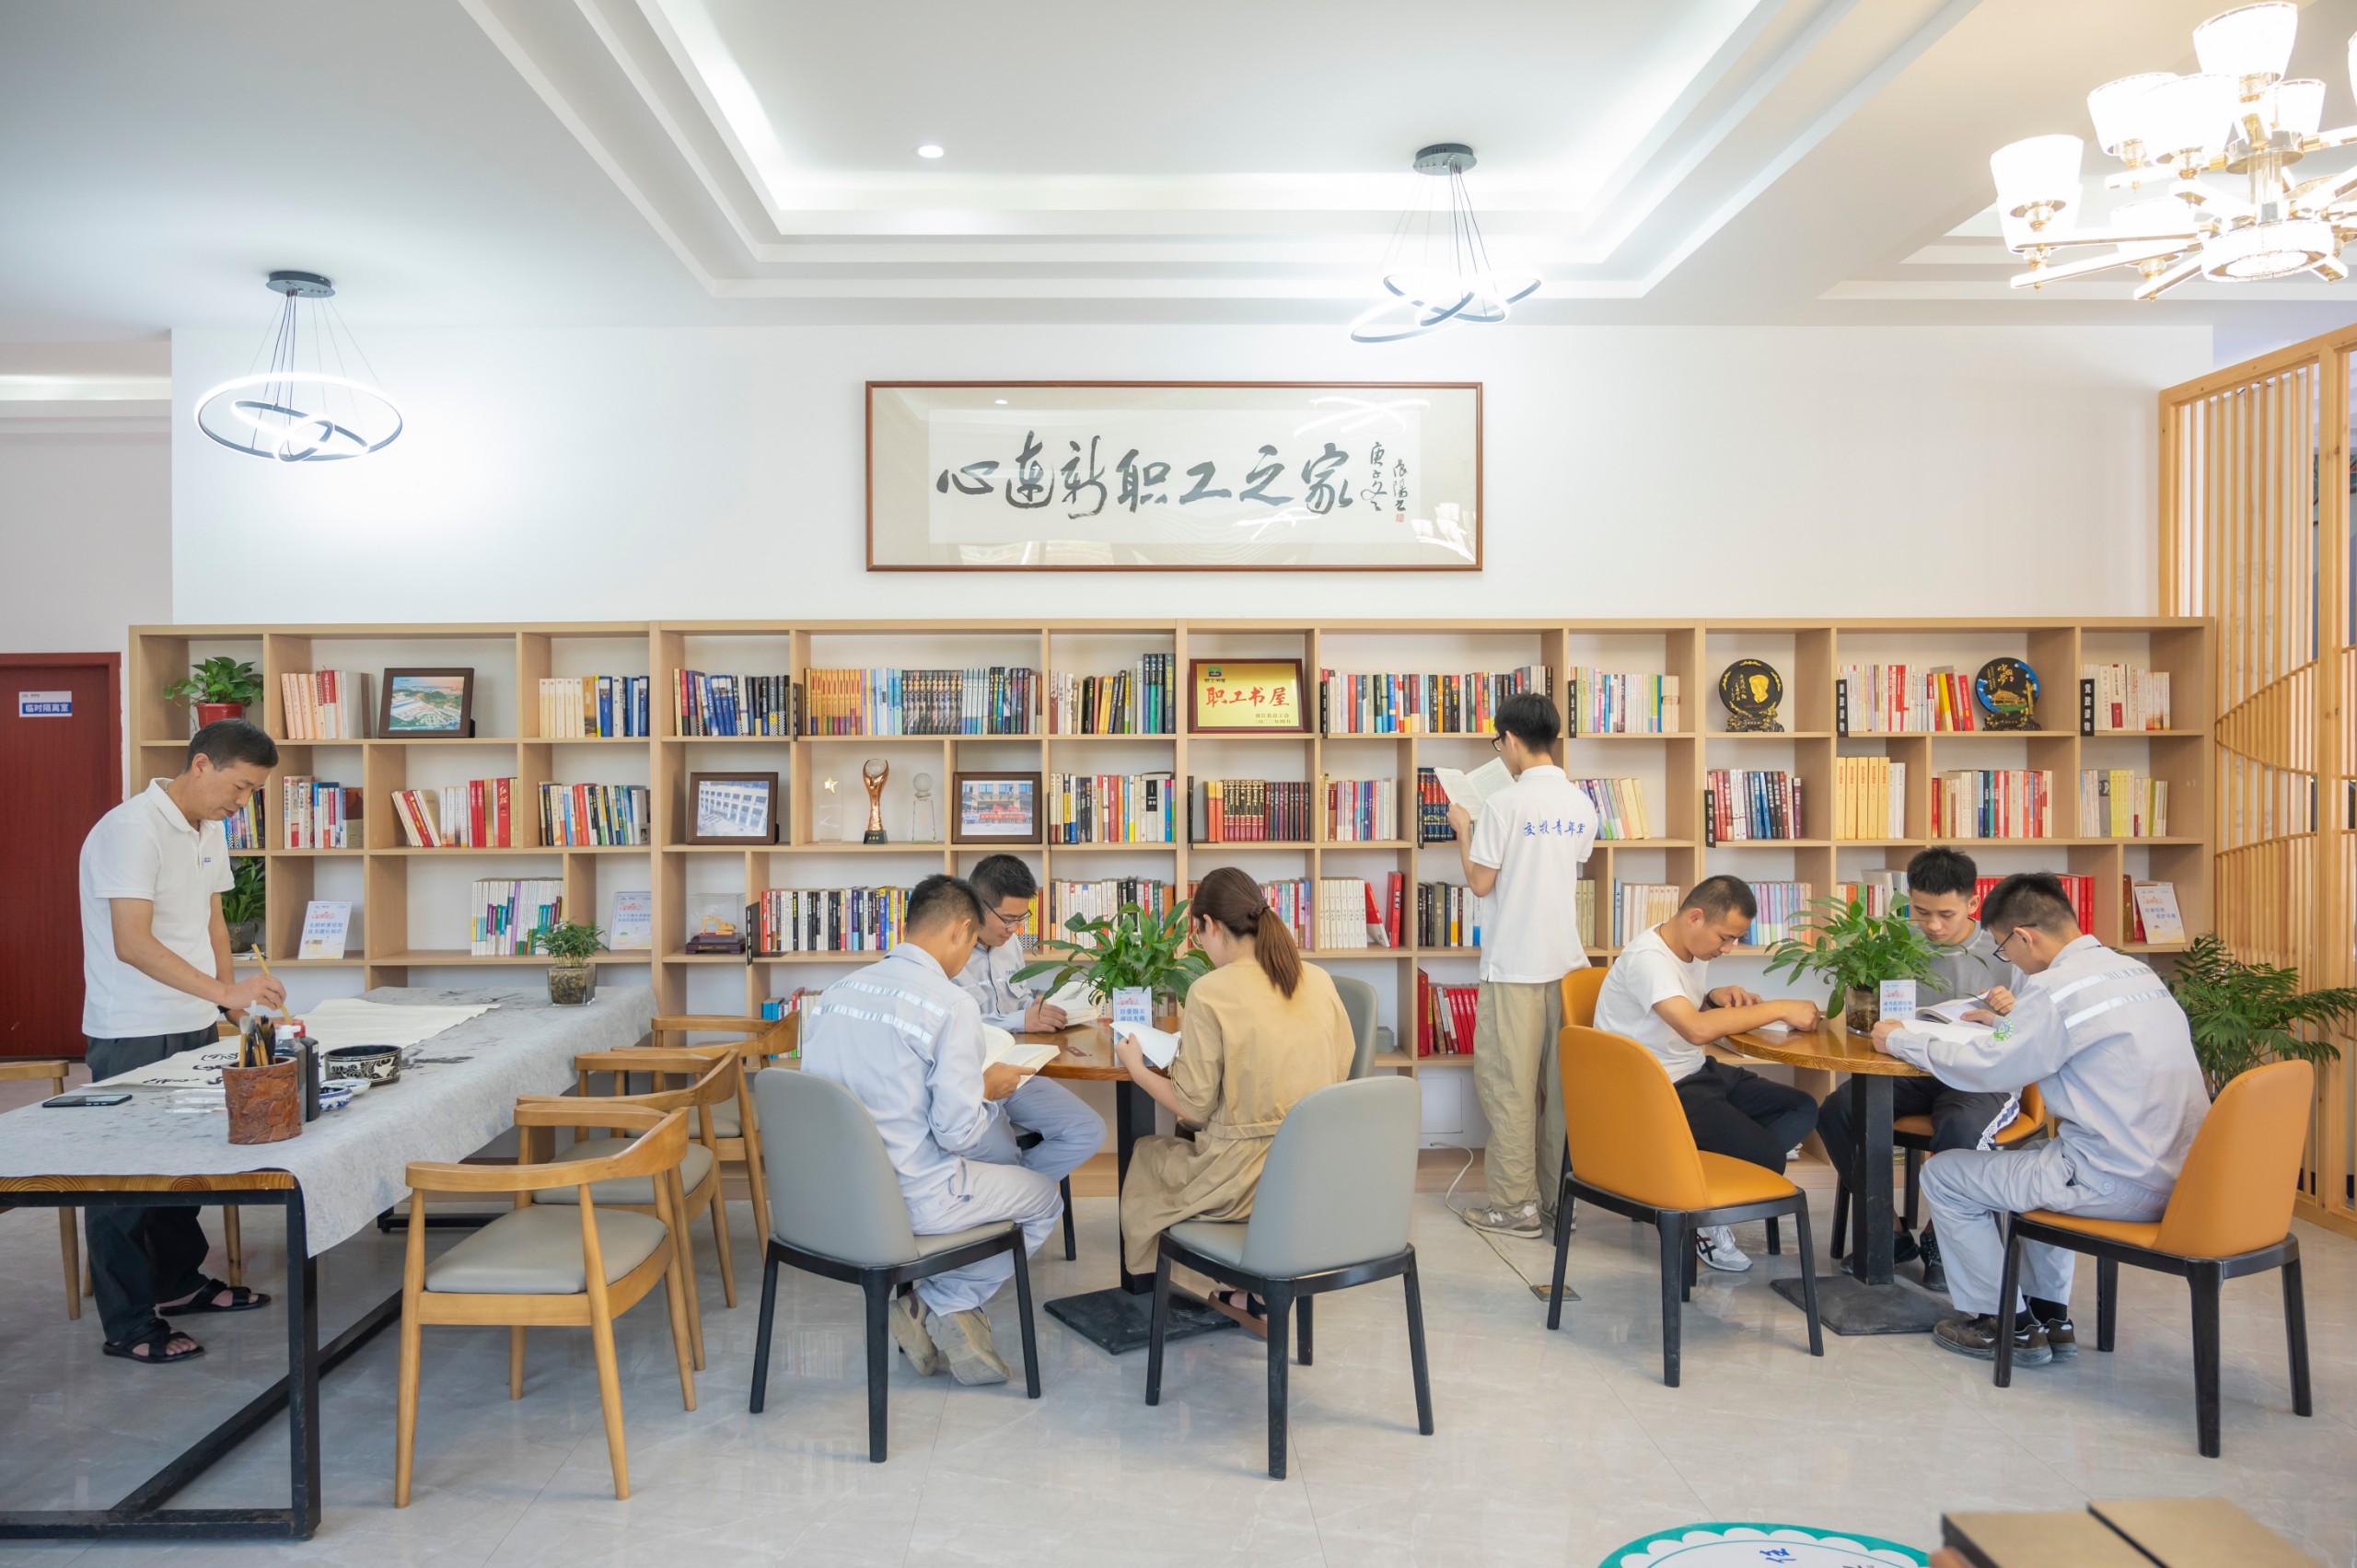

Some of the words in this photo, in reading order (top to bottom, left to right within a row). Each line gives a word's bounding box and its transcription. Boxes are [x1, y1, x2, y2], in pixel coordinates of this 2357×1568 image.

[1206, 686, 1290, 707] 职工书屋
[25, 703, 70, 714] 临时隔离室
[2084, 683, 2092, 732] 党政读物
